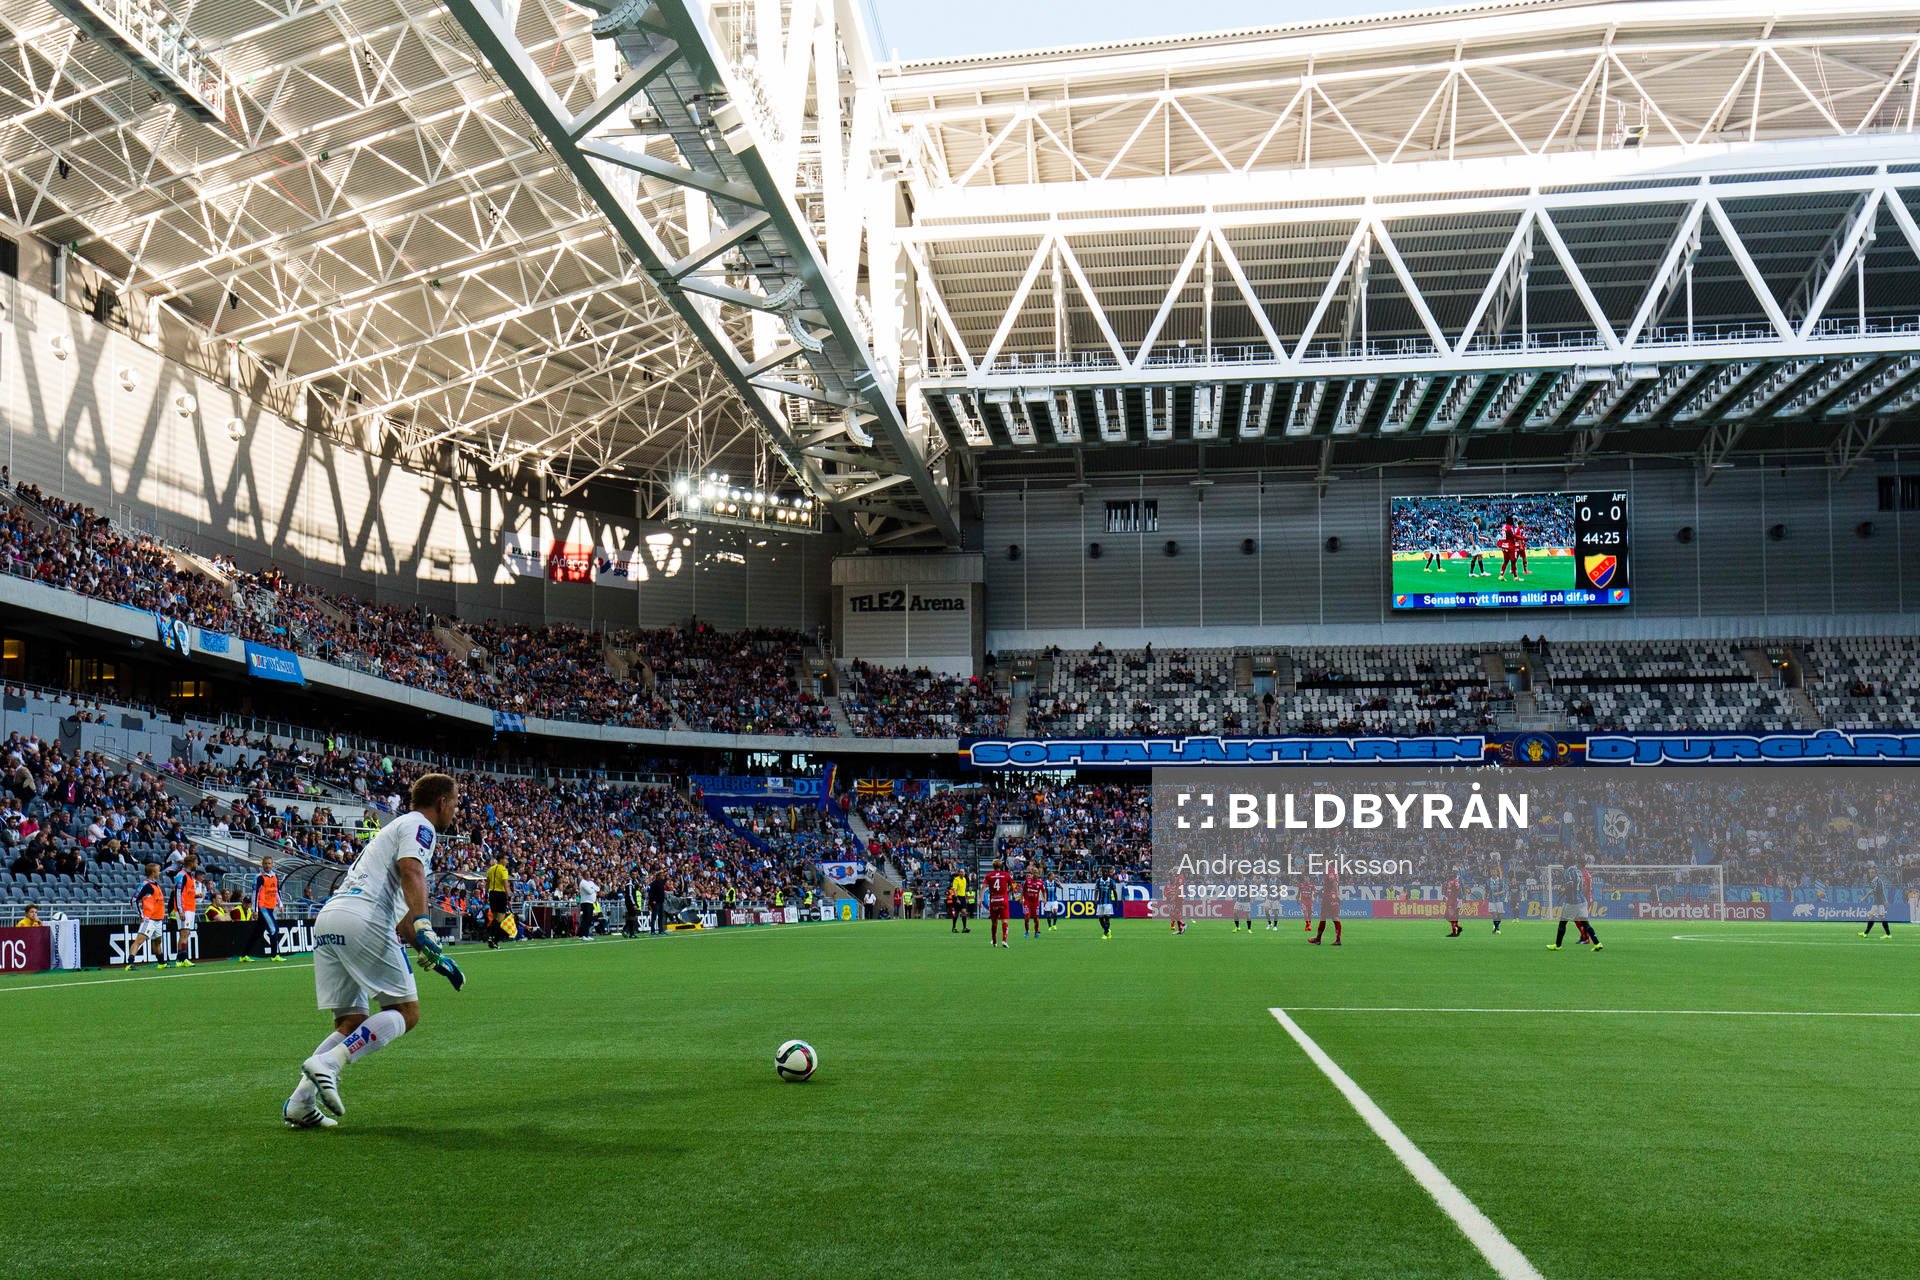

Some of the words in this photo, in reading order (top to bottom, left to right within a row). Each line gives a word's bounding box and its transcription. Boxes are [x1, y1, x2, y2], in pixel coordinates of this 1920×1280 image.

[1575, 495, 1588, 503] DIF
[1612, 493, 1627, 502] ÅFF
[1581, 506, 1591, 522] 0
[1610, 505, 1621, 521] 0
[1582, 531, 1620, 545] 44:25
[551, 554, 589, 571] Adecco
[850, 589, 906, 612] TELE2
[909, 595, 965, 612] Arena
[1423, 595, 1466, 605] Senaste
[1468, 594, 1489, 606] nytt
[1491, 593, 1518, 603] finns
[1520, 592, 1547, 602] alltid
[1550, 592, 1564, 604] på
[1566, 591, 1596, 602] dif.se
[993, 878, 1001, 891] 4
[1638, 902, 1710, 918] Prioritet
[1713, 903, 1766, 919] Finans
[1817, 906, 1888, 920] Björnklä
[0, 939, 27, 970] ns
